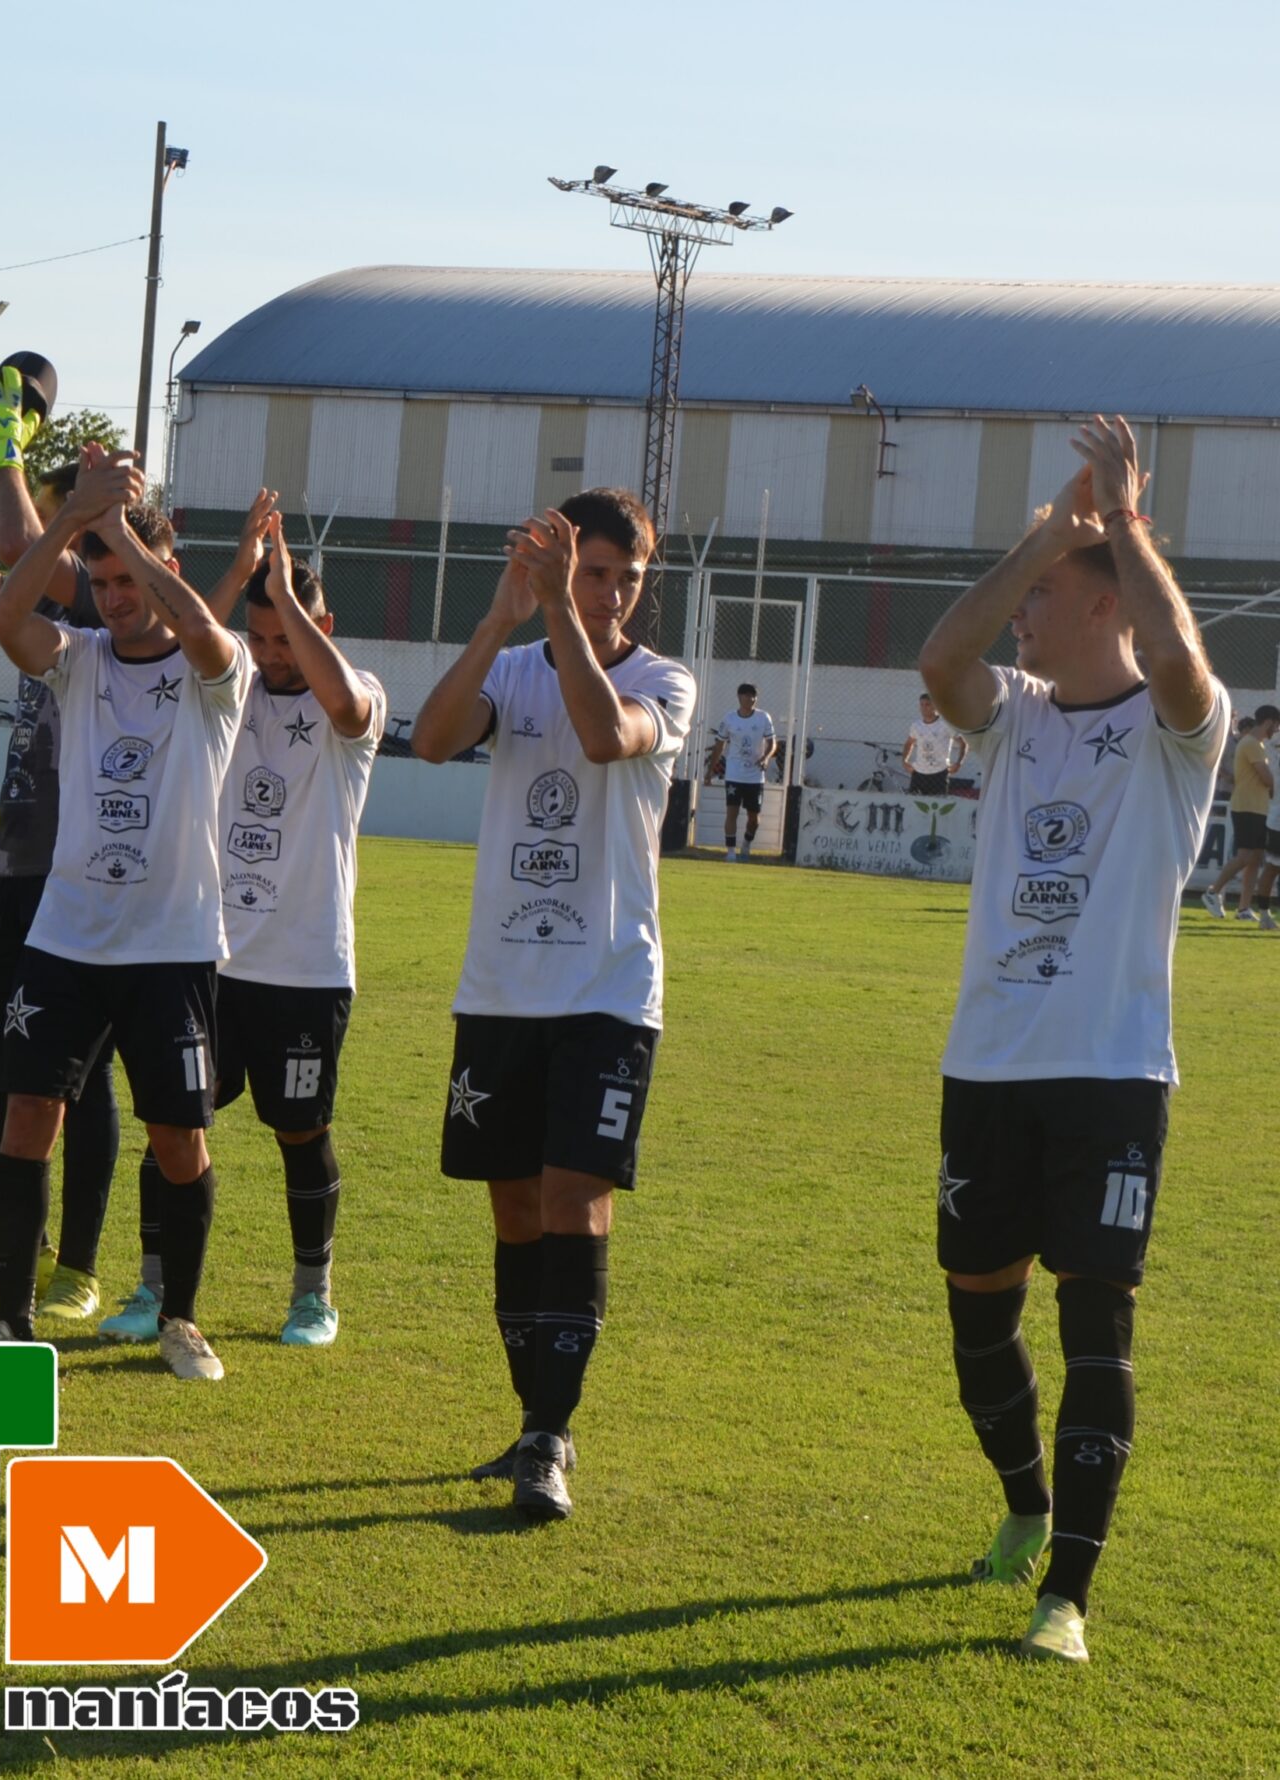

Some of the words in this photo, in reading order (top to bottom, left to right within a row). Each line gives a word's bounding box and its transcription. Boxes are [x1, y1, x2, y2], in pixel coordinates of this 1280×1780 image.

[100, 798, 134, 809] EXPO
[98, 808, 141, 819] ARNES
[233, 837, 273, 851] CARNES
[241, 830, 267, 843] EXPO
[812, 835, 859, 852] COMPRA
[101, 842, 143, 858] ONDRAS
[528, 848, 564, 861] EXPO
[519, 859, 570, 871] CARNES
[1027, 880, 1070, 892] EXPO
[1019, 892, 1079, 904] CARNES
[500, 910, 519, 929] LAS
[520, 898, 571, 913] ALONDRAS
[997, 946, 1017, 968] LAS
[1018, 934, 1069, 948] ALONDR
[182, 1044, 207, 1091] 11
[284, 1058, 322, 1099] 18
[596, 1087, 633, 1141] 5
[1099, 1171, 1148, 1232] 10
